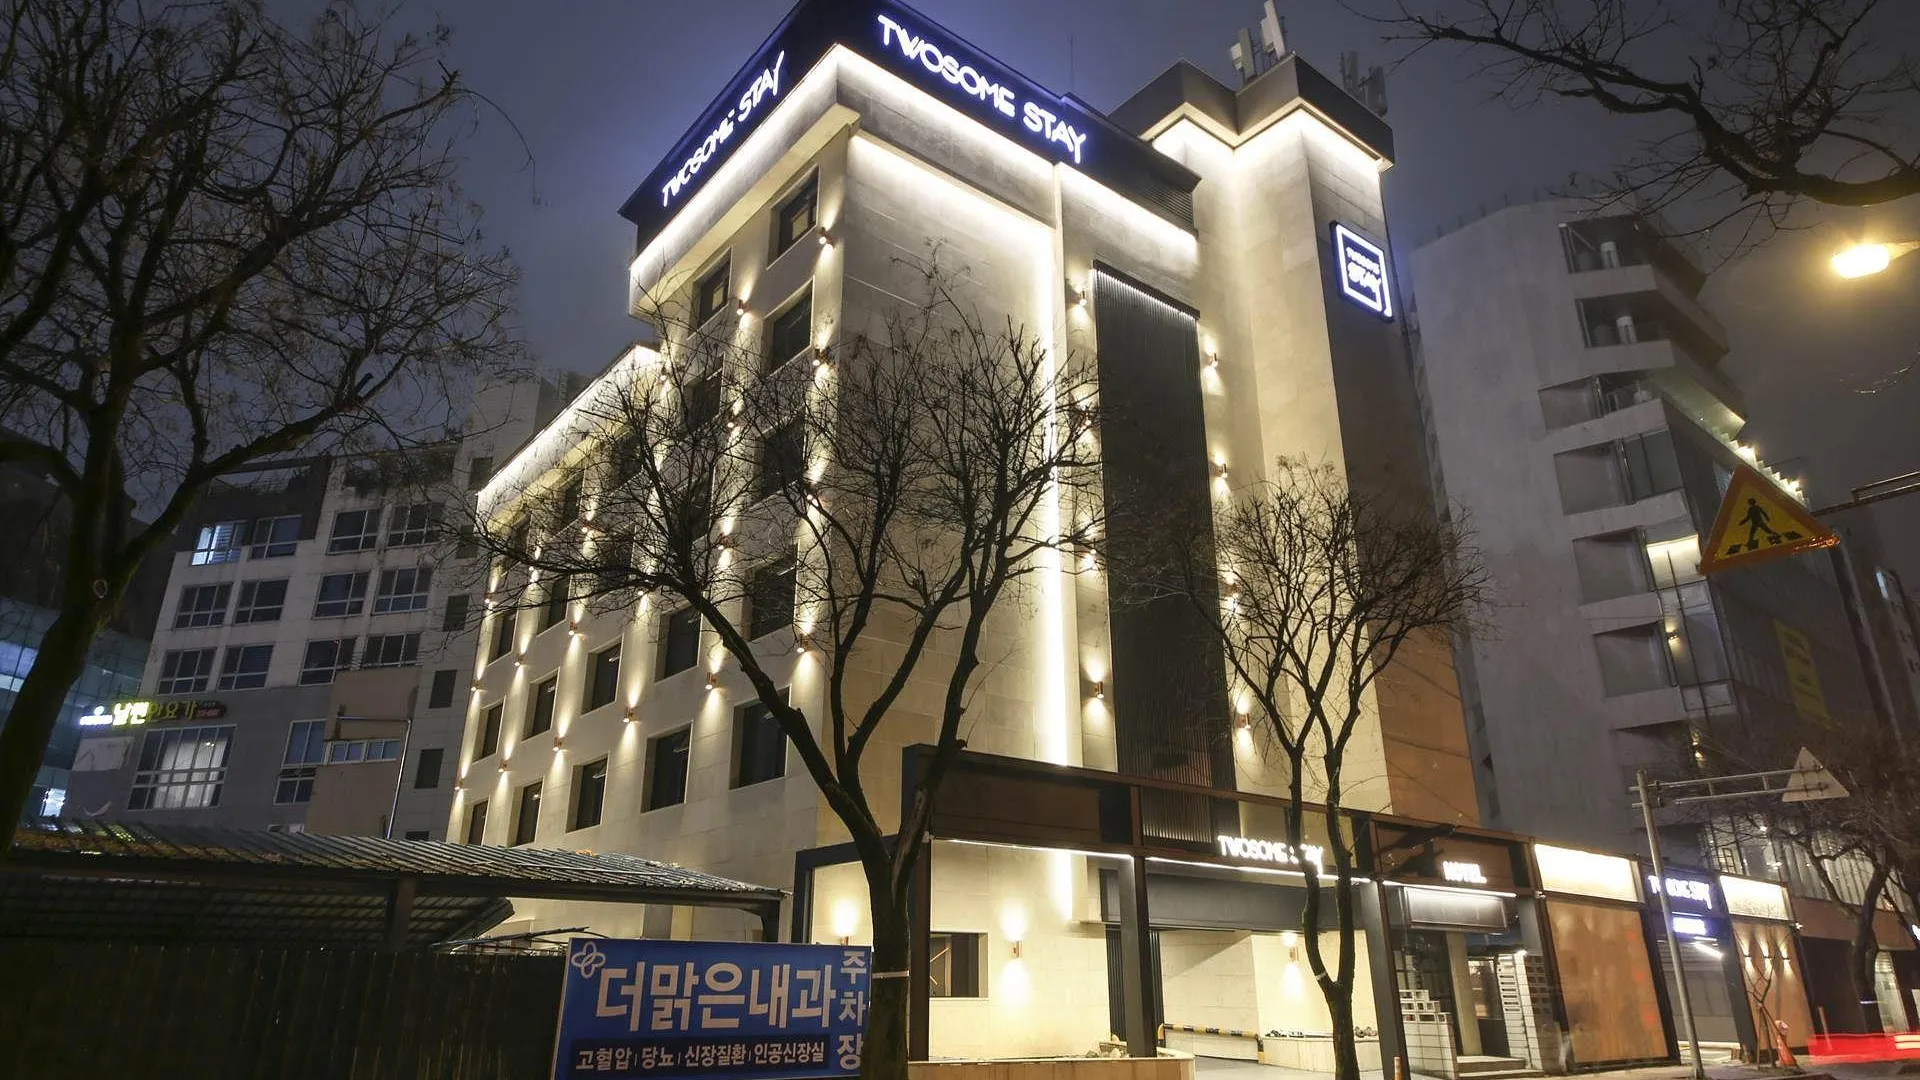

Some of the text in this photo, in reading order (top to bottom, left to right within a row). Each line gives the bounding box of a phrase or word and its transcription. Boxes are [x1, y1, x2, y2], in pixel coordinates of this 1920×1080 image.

[738, 50, 785, 122] STAY
[877, 14, 1087, 164] TWOSOME STAY
[1217, 835, 1288, 864] TWOSOME
[837, 950, 868, 1070] 주차장
[576, 1041, 825, 1071] 고혈압 당뇨 신장질환 인공신장실
